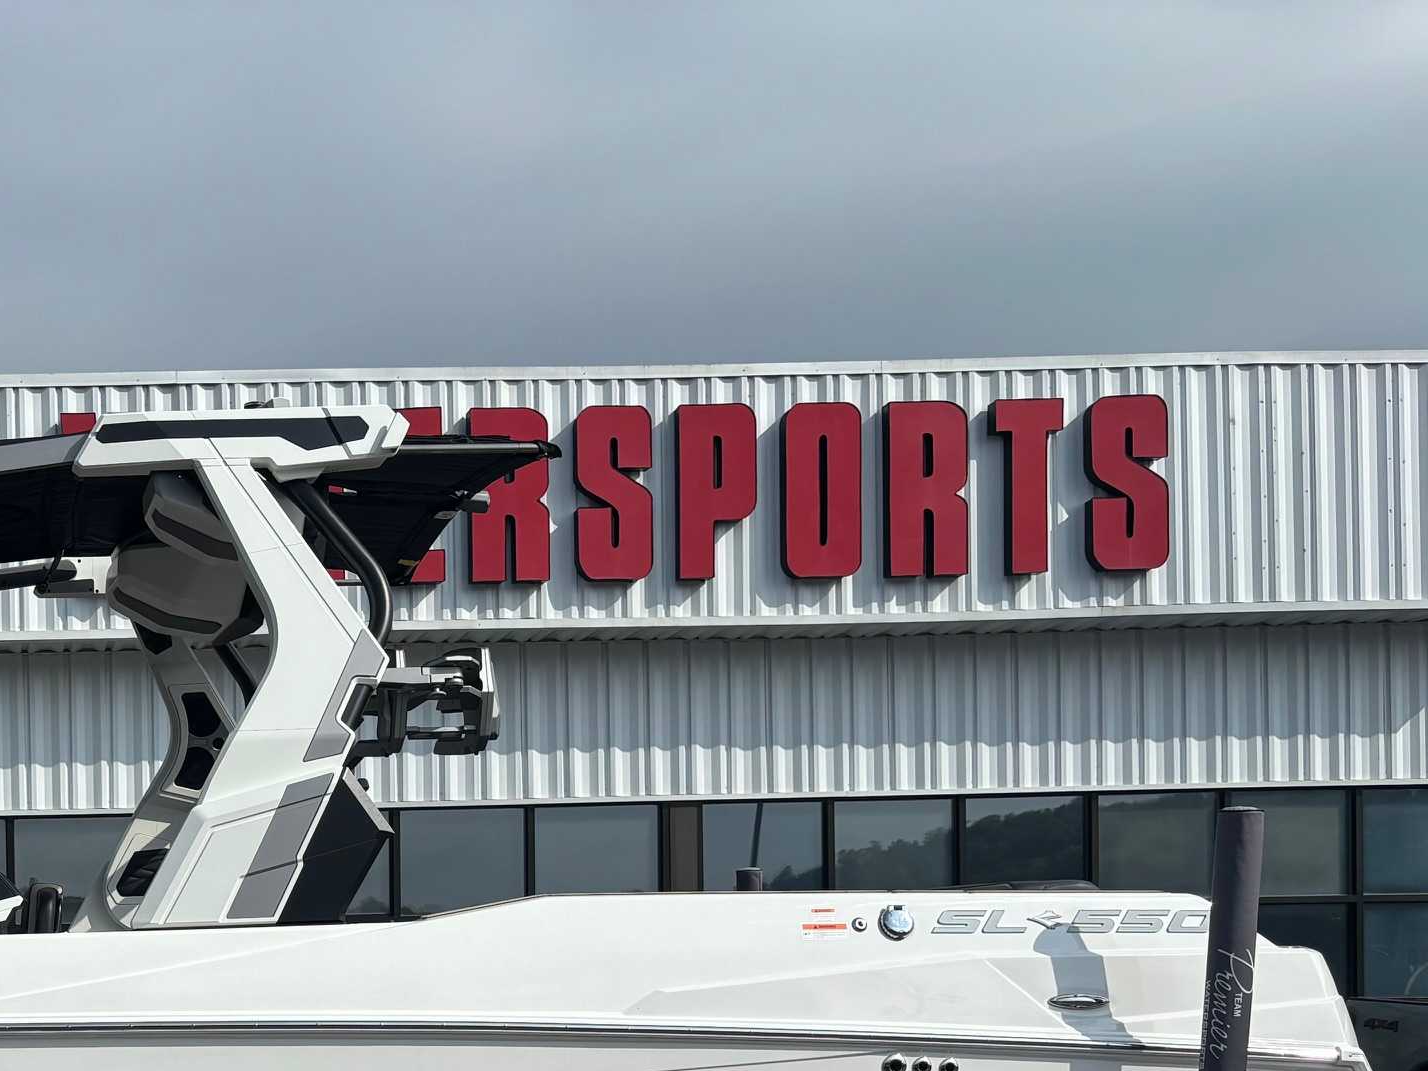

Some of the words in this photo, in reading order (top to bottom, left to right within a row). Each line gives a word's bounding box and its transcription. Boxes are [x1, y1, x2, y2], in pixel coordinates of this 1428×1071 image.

[60, 394, 1170, 585] RSPORTS
[931, 909, 1027, 934] SL
[1209, 948, 1255, 1060] Premier
[1233, 992, 1243, 1017] TEAM
